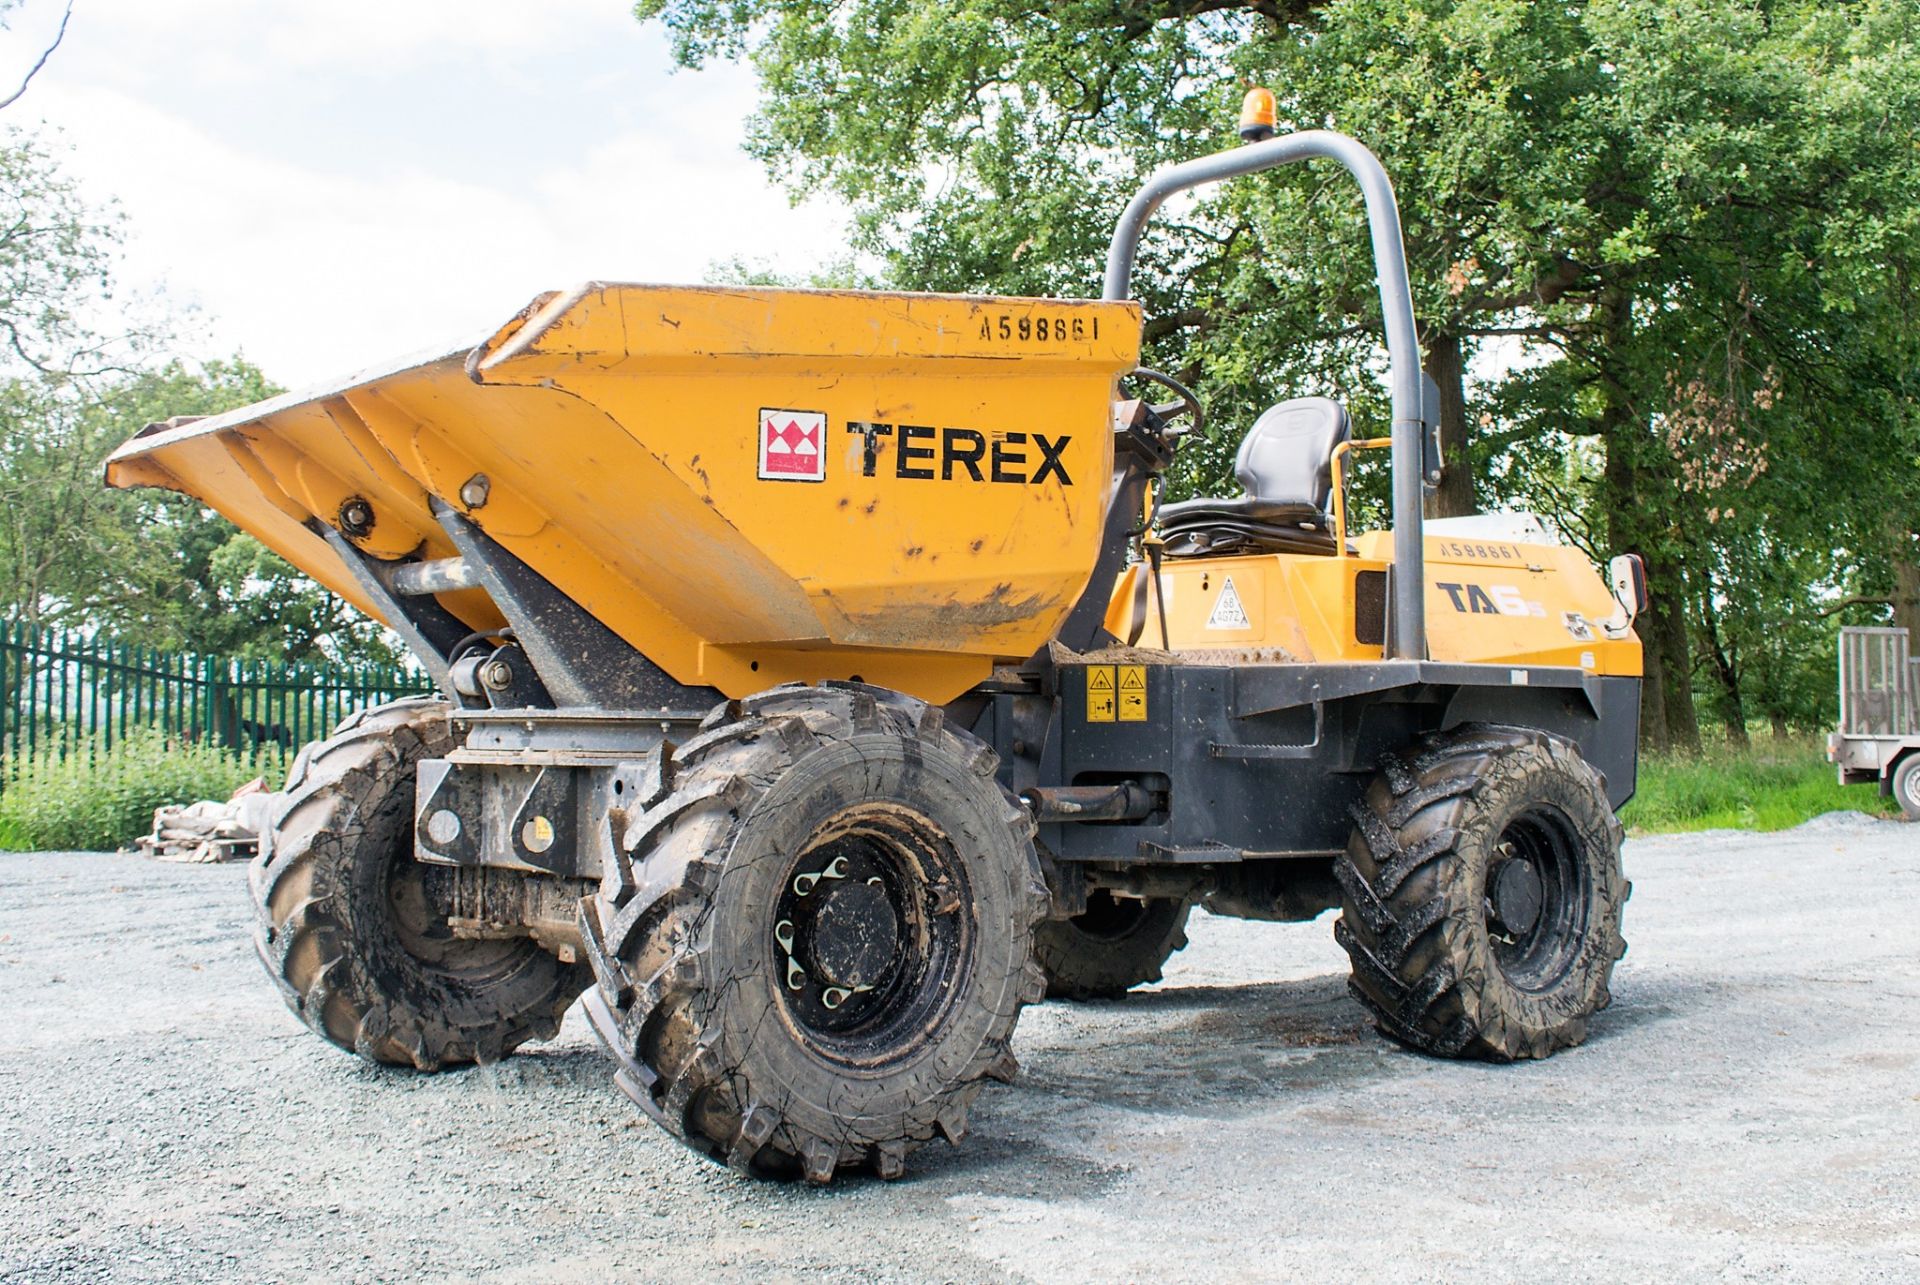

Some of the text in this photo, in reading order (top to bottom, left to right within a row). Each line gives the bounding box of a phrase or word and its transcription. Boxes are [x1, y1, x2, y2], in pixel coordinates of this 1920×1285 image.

[979, 315, 1098, 341] A598861
[846, 421, 1074, 486] TEREX
[1440, 543, 1522, 559] A598861
